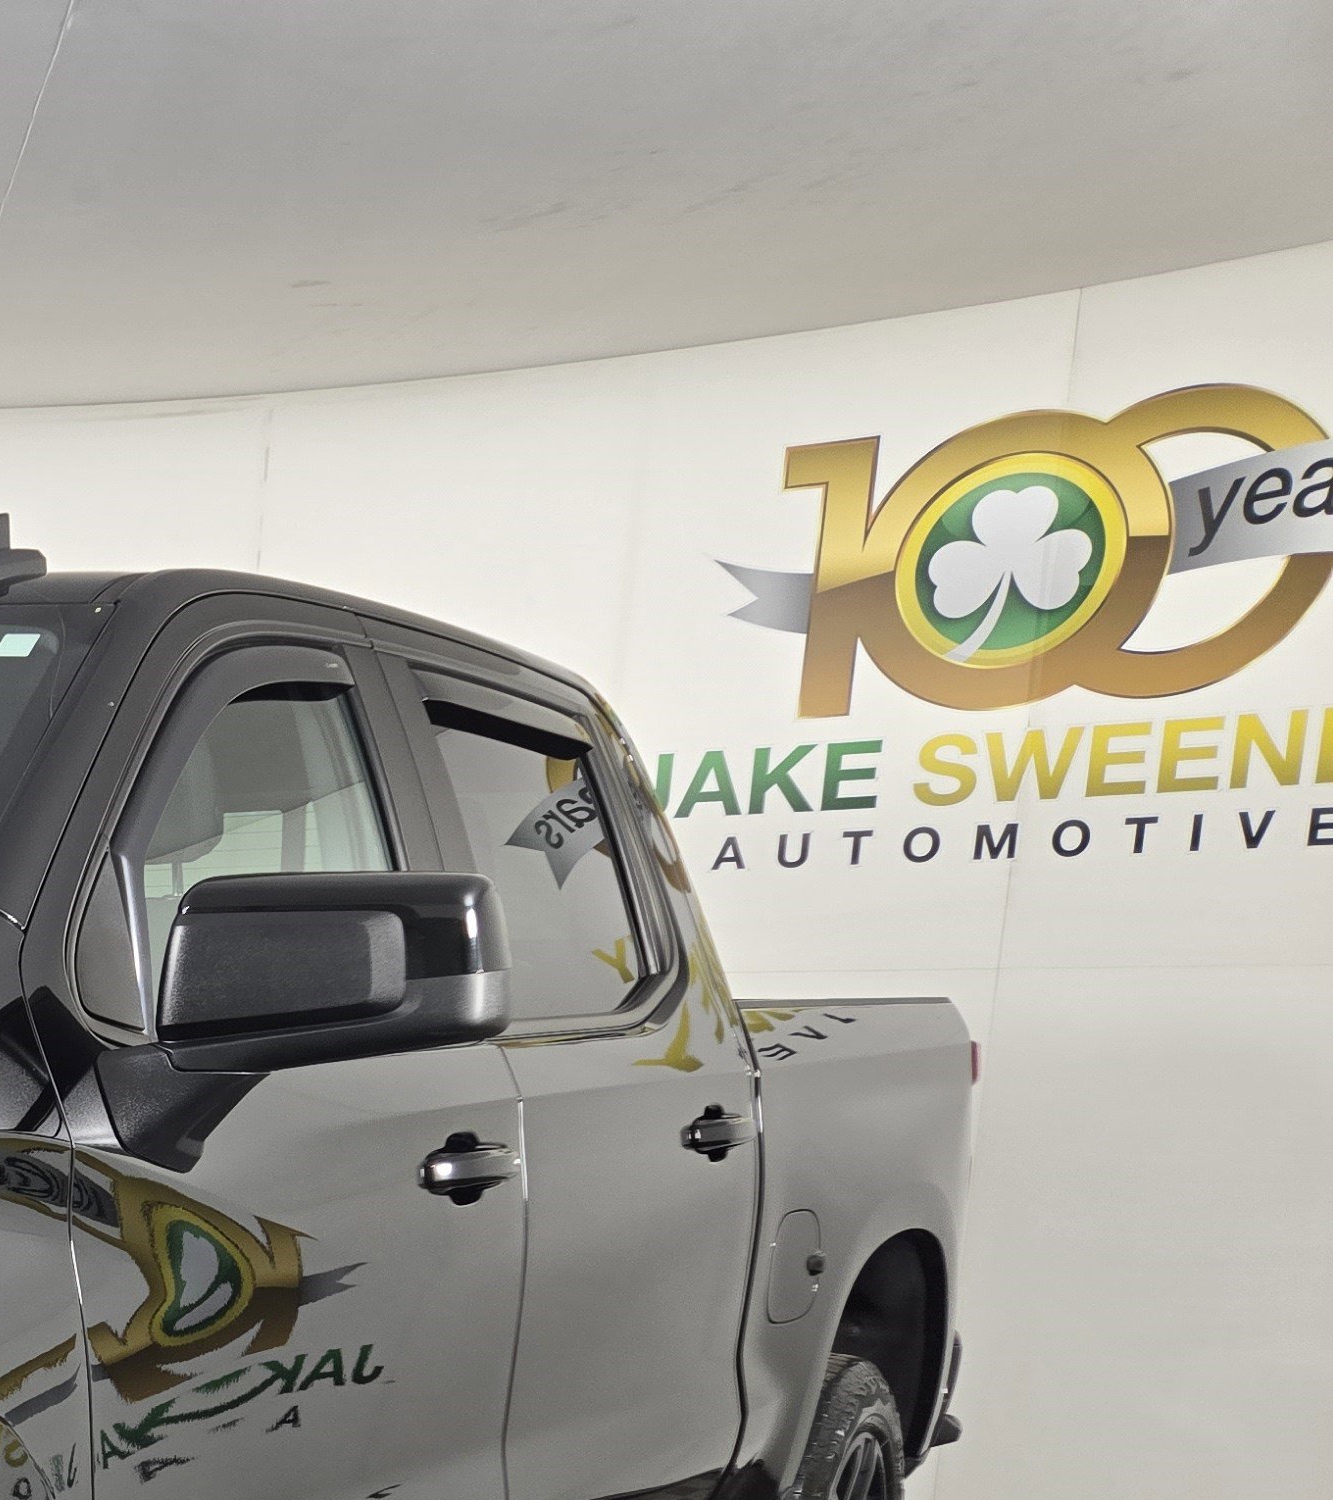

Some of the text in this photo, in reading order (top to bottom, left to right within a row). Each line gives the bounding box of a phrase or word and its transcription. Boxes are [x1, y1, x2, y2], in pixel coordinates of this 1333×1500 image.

[1188, 457, 1333, 557] yea
[913, 707, 1333, 807] SWEEN
[711, 807, 1333, 871] AUTOMOTIVE
